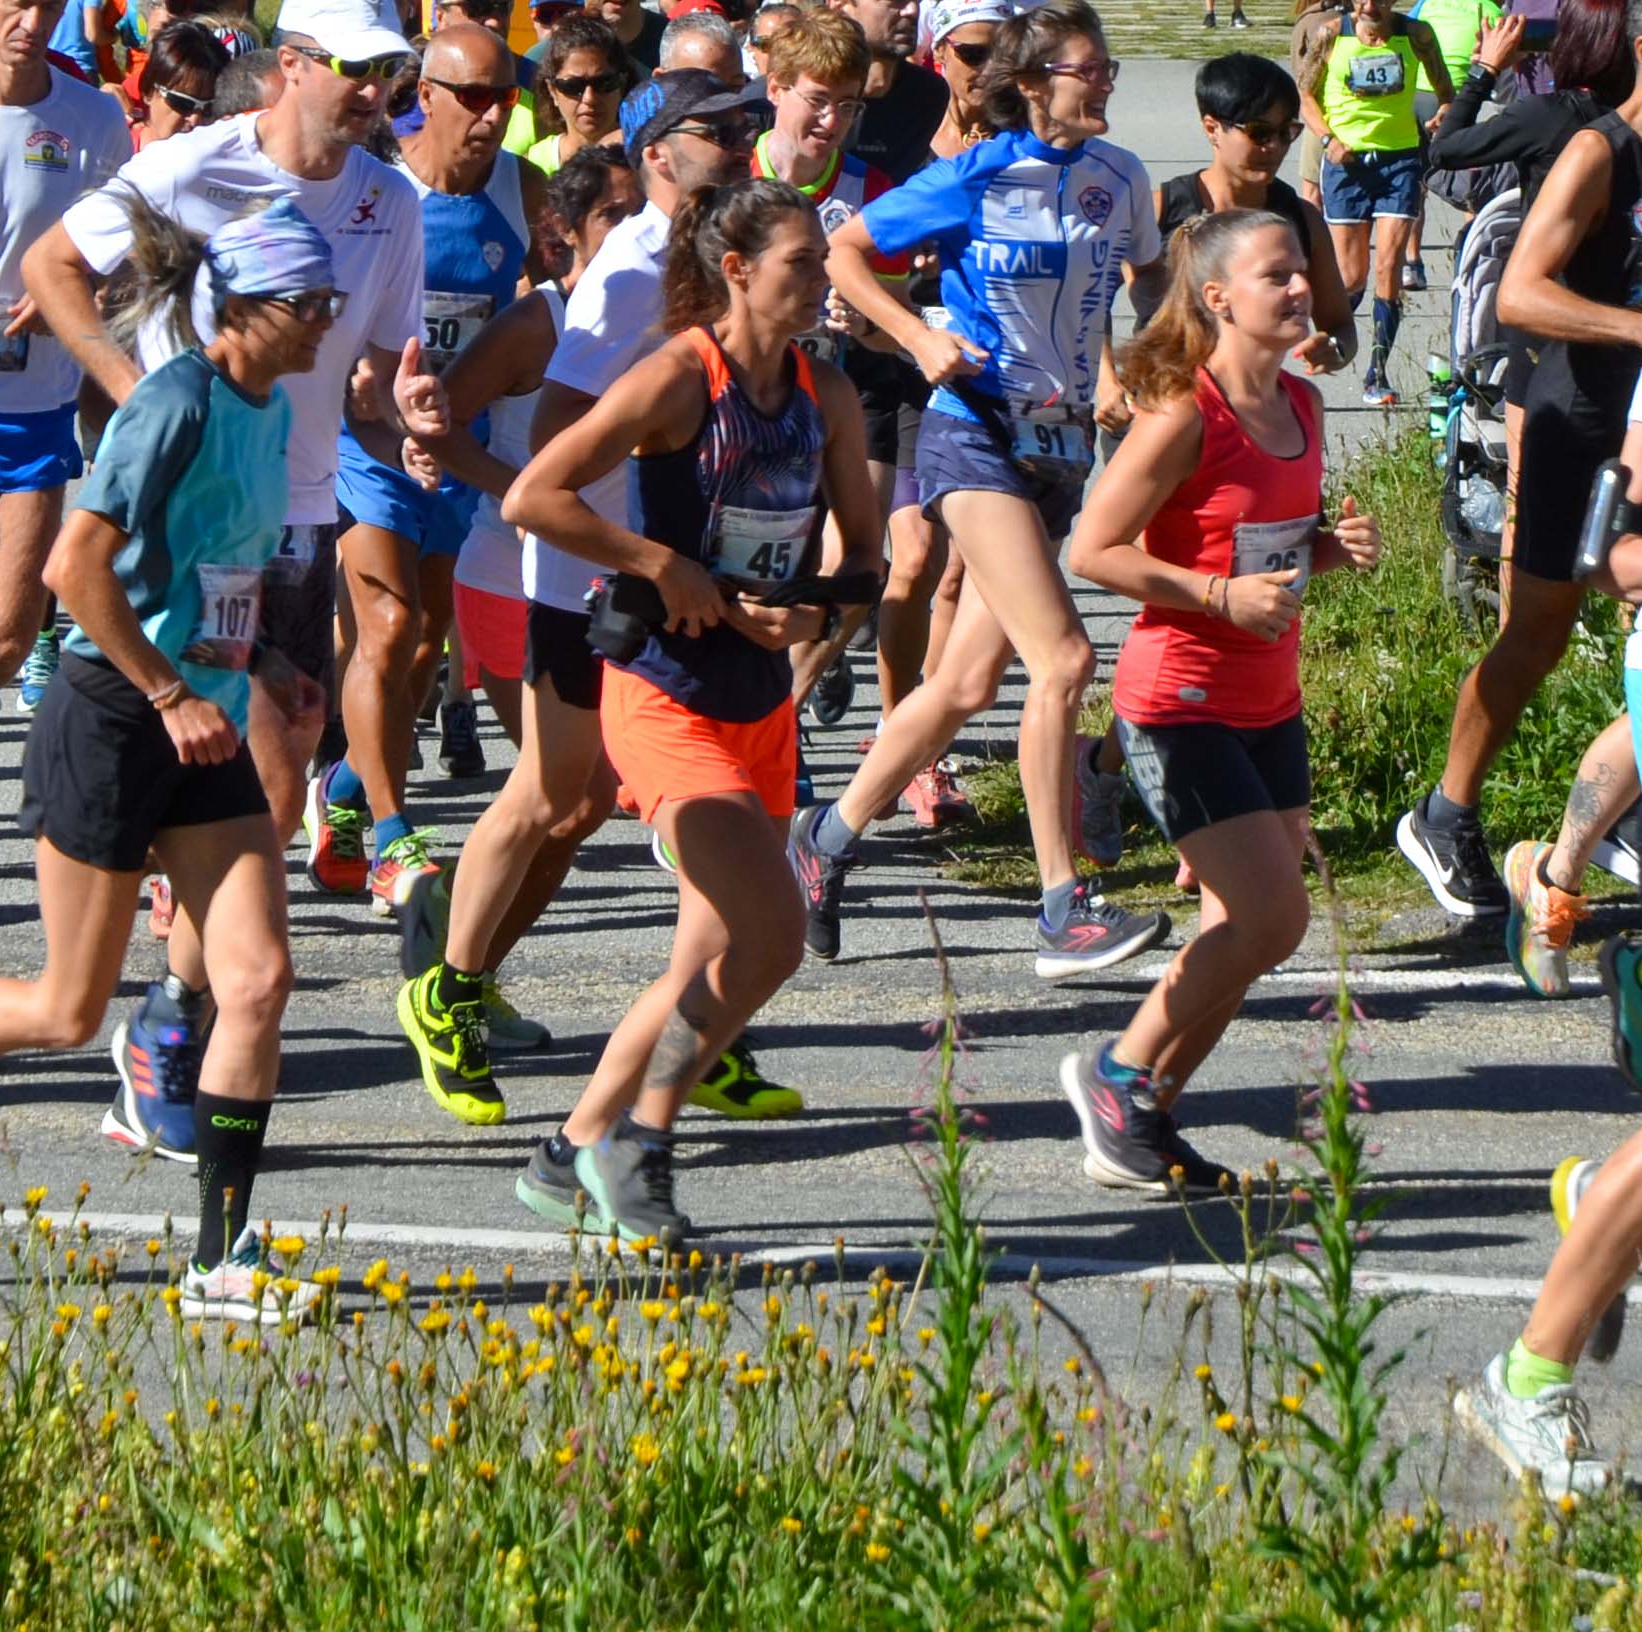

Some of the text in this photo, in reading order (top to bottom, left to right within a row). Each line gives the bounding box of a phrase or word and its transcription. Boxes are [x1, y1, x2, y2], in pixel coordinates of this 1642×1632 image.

[1365, 68, 1388, 84] 43
[971, 239, 1053, 275] TRAIL
[1035, 423, 1066, 456] 91
[747, 542, 791, 579] 45
[214, 597, 251, 637] 107
